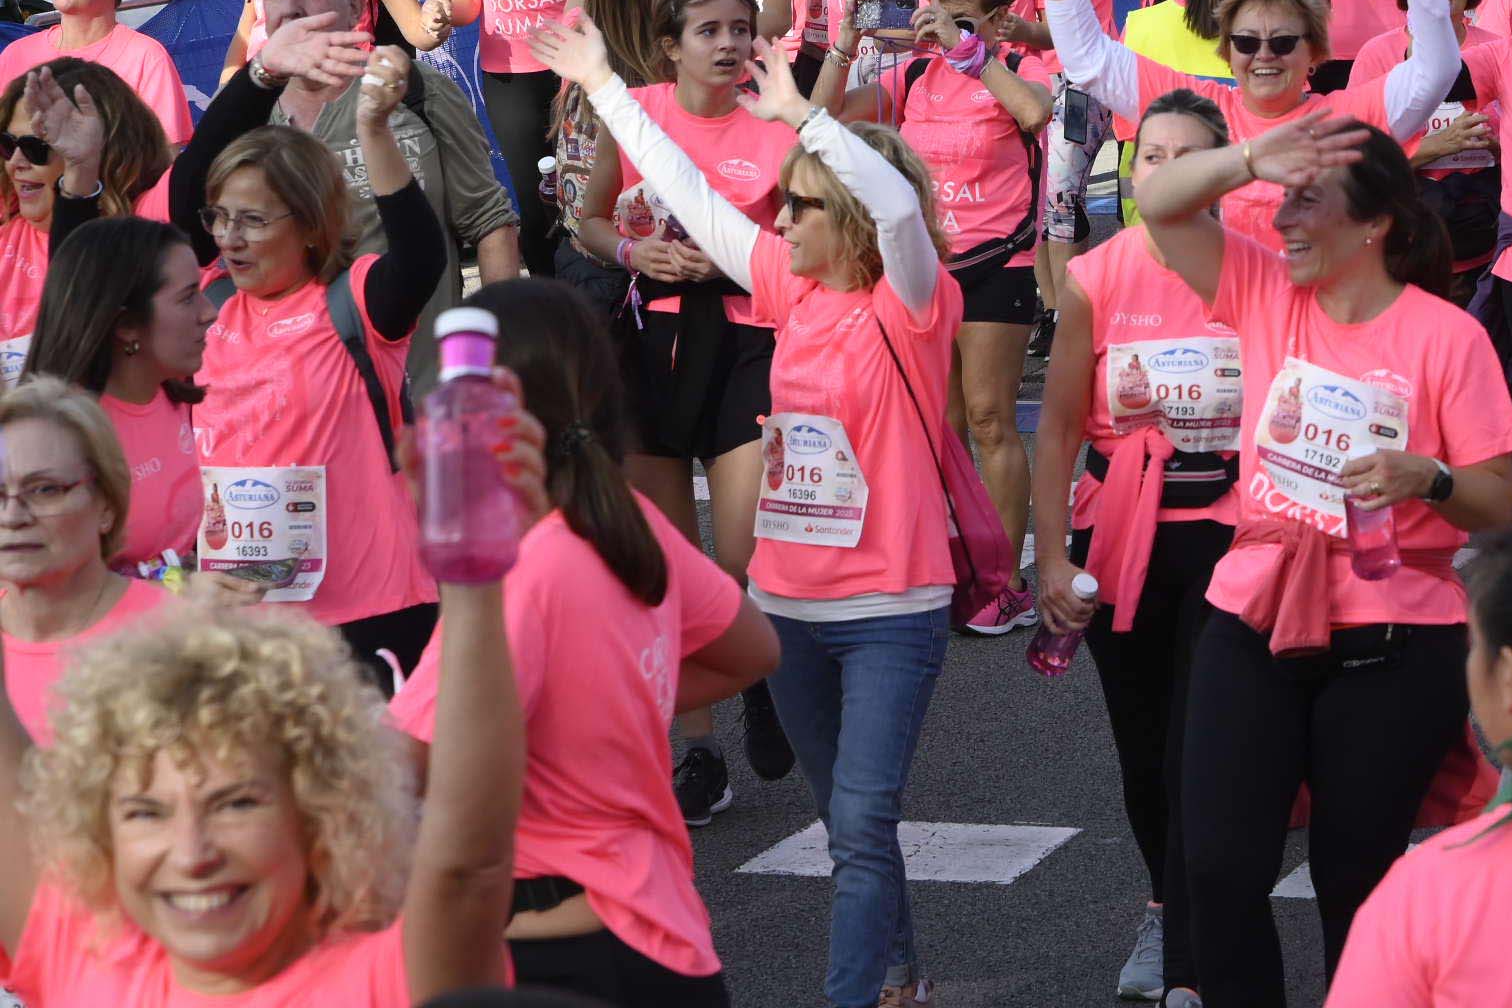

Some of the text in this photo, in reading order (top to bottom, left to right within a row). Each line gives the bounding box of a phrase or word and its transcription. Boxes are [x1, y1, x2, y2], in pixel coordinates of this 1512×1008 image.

[861, 46, 876, 55] 01
[1432, 117, 1451, 130] 01
[1155, 383, 1202, 400] 016
[1304, 423, 1351, 451] 016
[1304, 448, 1341, 468] 17192
[785, 464, 823, 484] 016
[787, 487, 817, 501] 16396
[231, 520, 273, 539] 016
[814, 525, 853, 536] Santander
[235, 545, 268, 557] 16393
